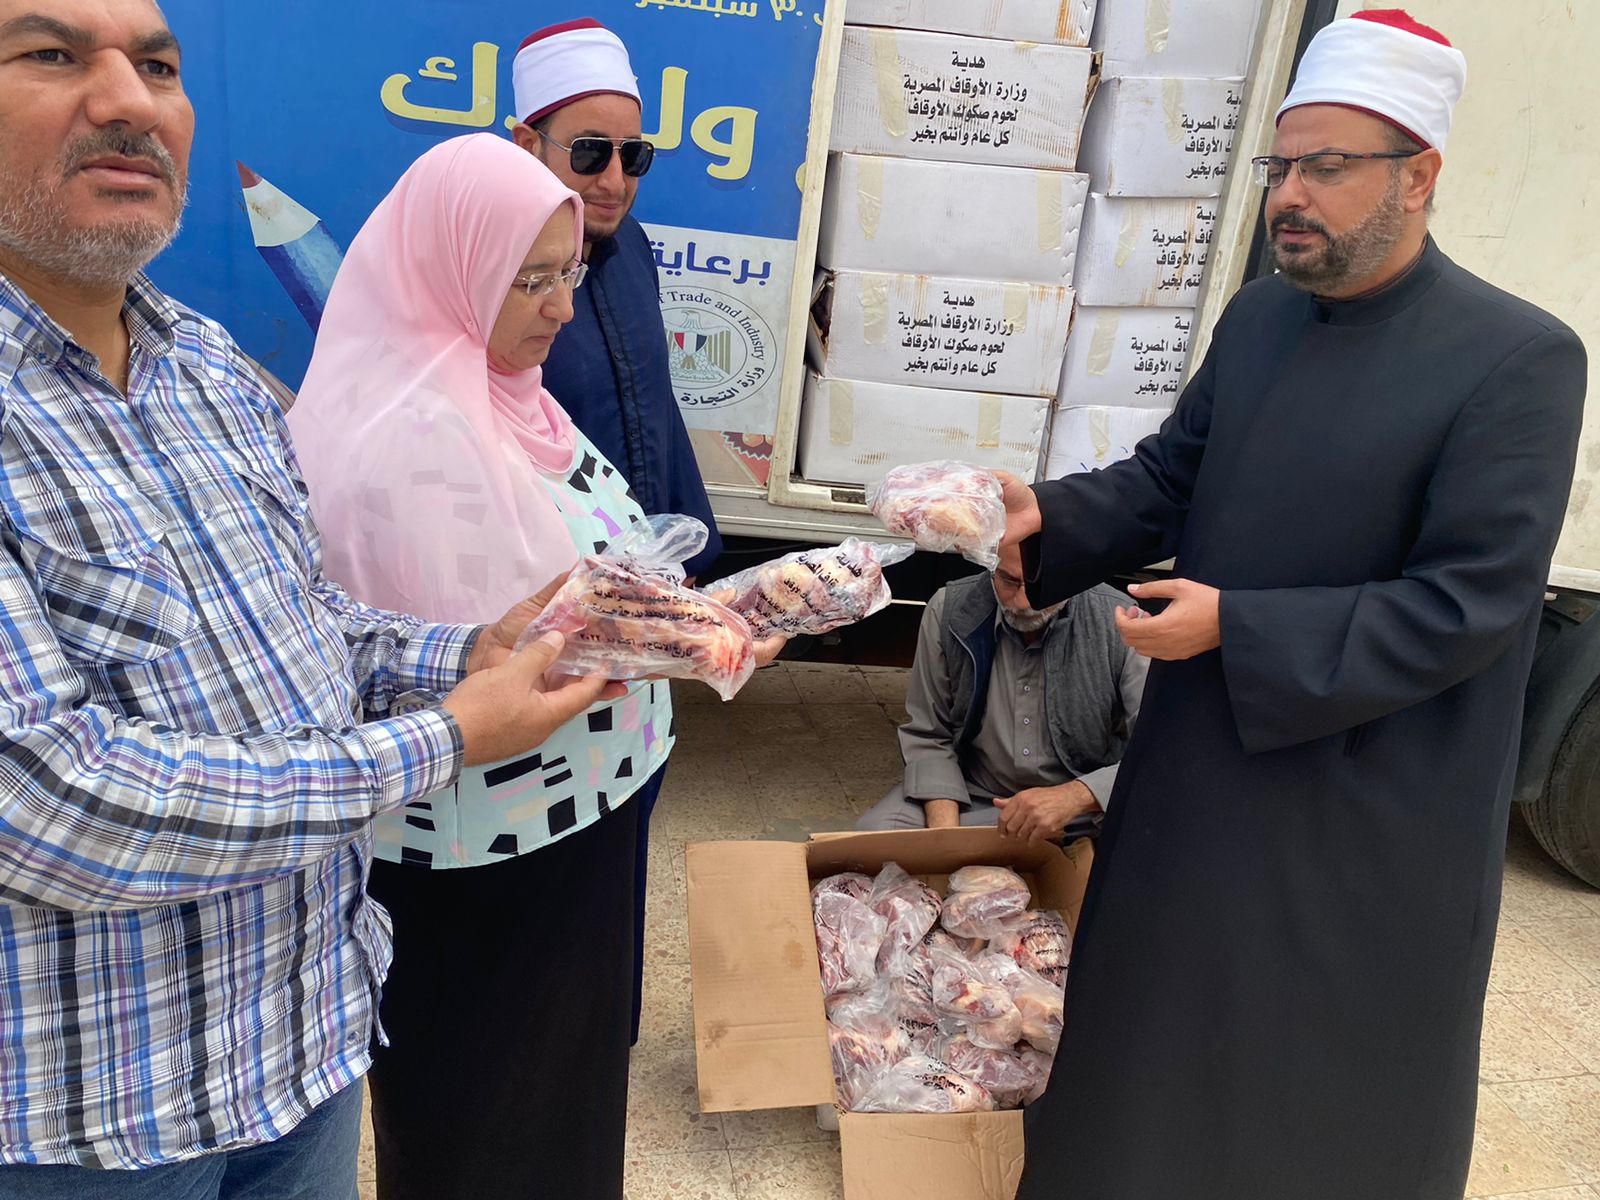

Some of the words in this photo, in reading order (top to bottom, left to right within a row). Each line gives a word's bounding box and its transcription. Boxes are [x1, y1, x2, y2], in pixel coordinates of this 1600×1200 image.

[951, 51, 986, 72] هدية
[903, 74, 945, 95] المصرية
[950, 76, 991, 98] الأوقاف
[996, 81, 1027, 102] وزارة
[908, 97, 949, 119] الأوقاف
[1226, 90, 1241, 109] ية
[952, 104, 990, 122] صكوك
[991, 108, 1018, 124] لحوم
[1181, 114, 1220, 132] المصرية
[911, 125, 937, 144] بخير
[971, 129, 990, 146] عام
[993, 130, 1010, 147] كل
[1185, 136, 1222, 156] الأوقاف
[1186, 161, 1211, 179] بخير
[1196, 206, 1216, 224] ية
[1152, 230, 1191, 247] المصرية
[1156, 249, 1194, 269] الأوقاف
[1158, 273, 1182, 290] بخير
[943, 291, 975, 310] هدية
[667, 291, 712, 305] Trade
[715, 301, 742, 318] and
[738, 316, 765, 360] Industry
[898, 311, 937, 330] المصرية
[940, 313, 981, 333] الأوقاف
[984, 318, 1014, 336] وزارة
[1174, 316, 1190, 334] ية
[901, 332, 941, 352] الأوقاف
[944, 338, 978, 354] صكوك
[980, 341, 1005, 356] لحوم
[1131, 337, 1169, 354] المصرية
[904, 357, 928, 373] بخير
[930, 357, 958, 374] وأنتم
[960, 361, 979, 375] عام
[981, 361, 998, 376] كل
[1134, 357, 1172, 375] الأوقاف
[736, 367, 765, 388] وزارة
[680, 387, 740, 405] التجارة
[1134, 380, 1159, 395] بخير
[1160, 380, 1178, 395] نتم
[836, 552, 862, 578] هدية
